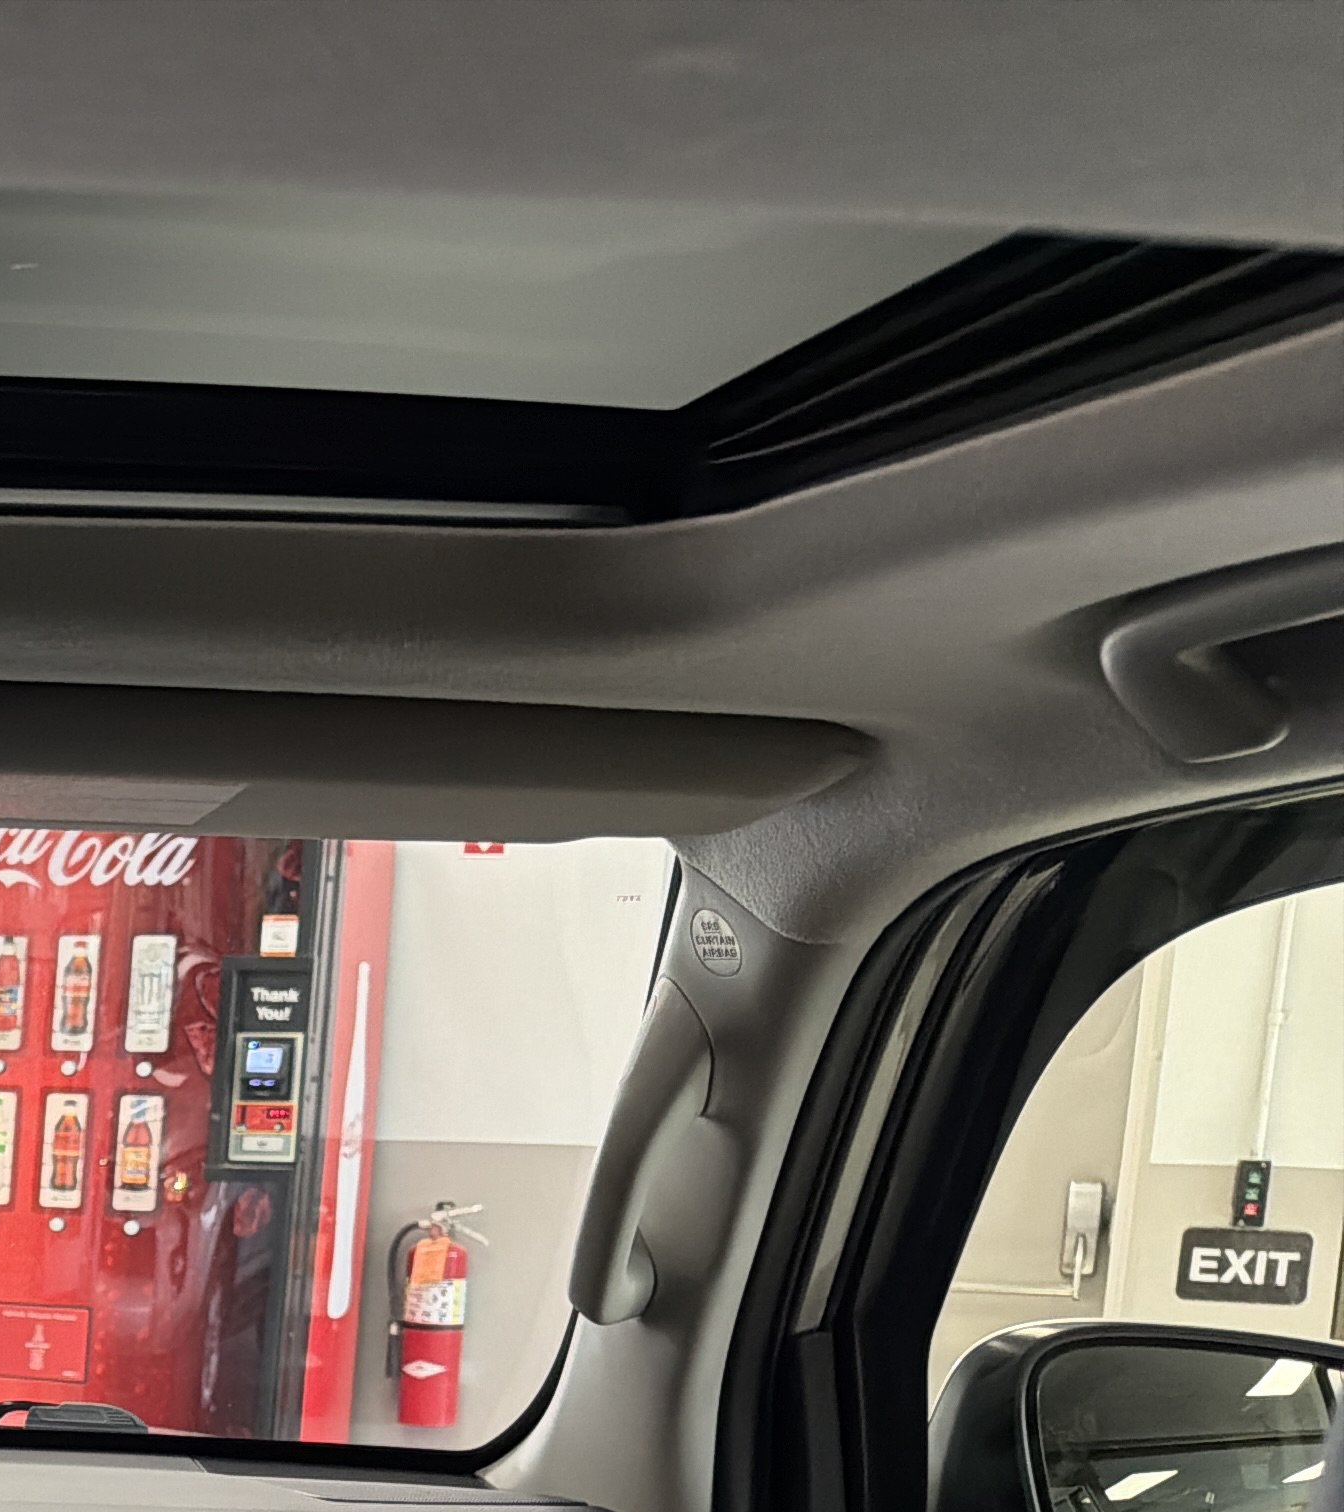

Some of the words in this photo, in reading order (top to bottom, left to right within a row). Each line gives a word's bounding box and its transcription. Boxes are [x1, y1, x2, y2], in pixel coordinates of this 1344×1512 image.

[695, 935, 736, 946] CURTAIN
[251, 986, 301, 1003] Thank
[255, 1005, 292, 1021] You!
[1188, 1247, 1301, 1288] EXIT
